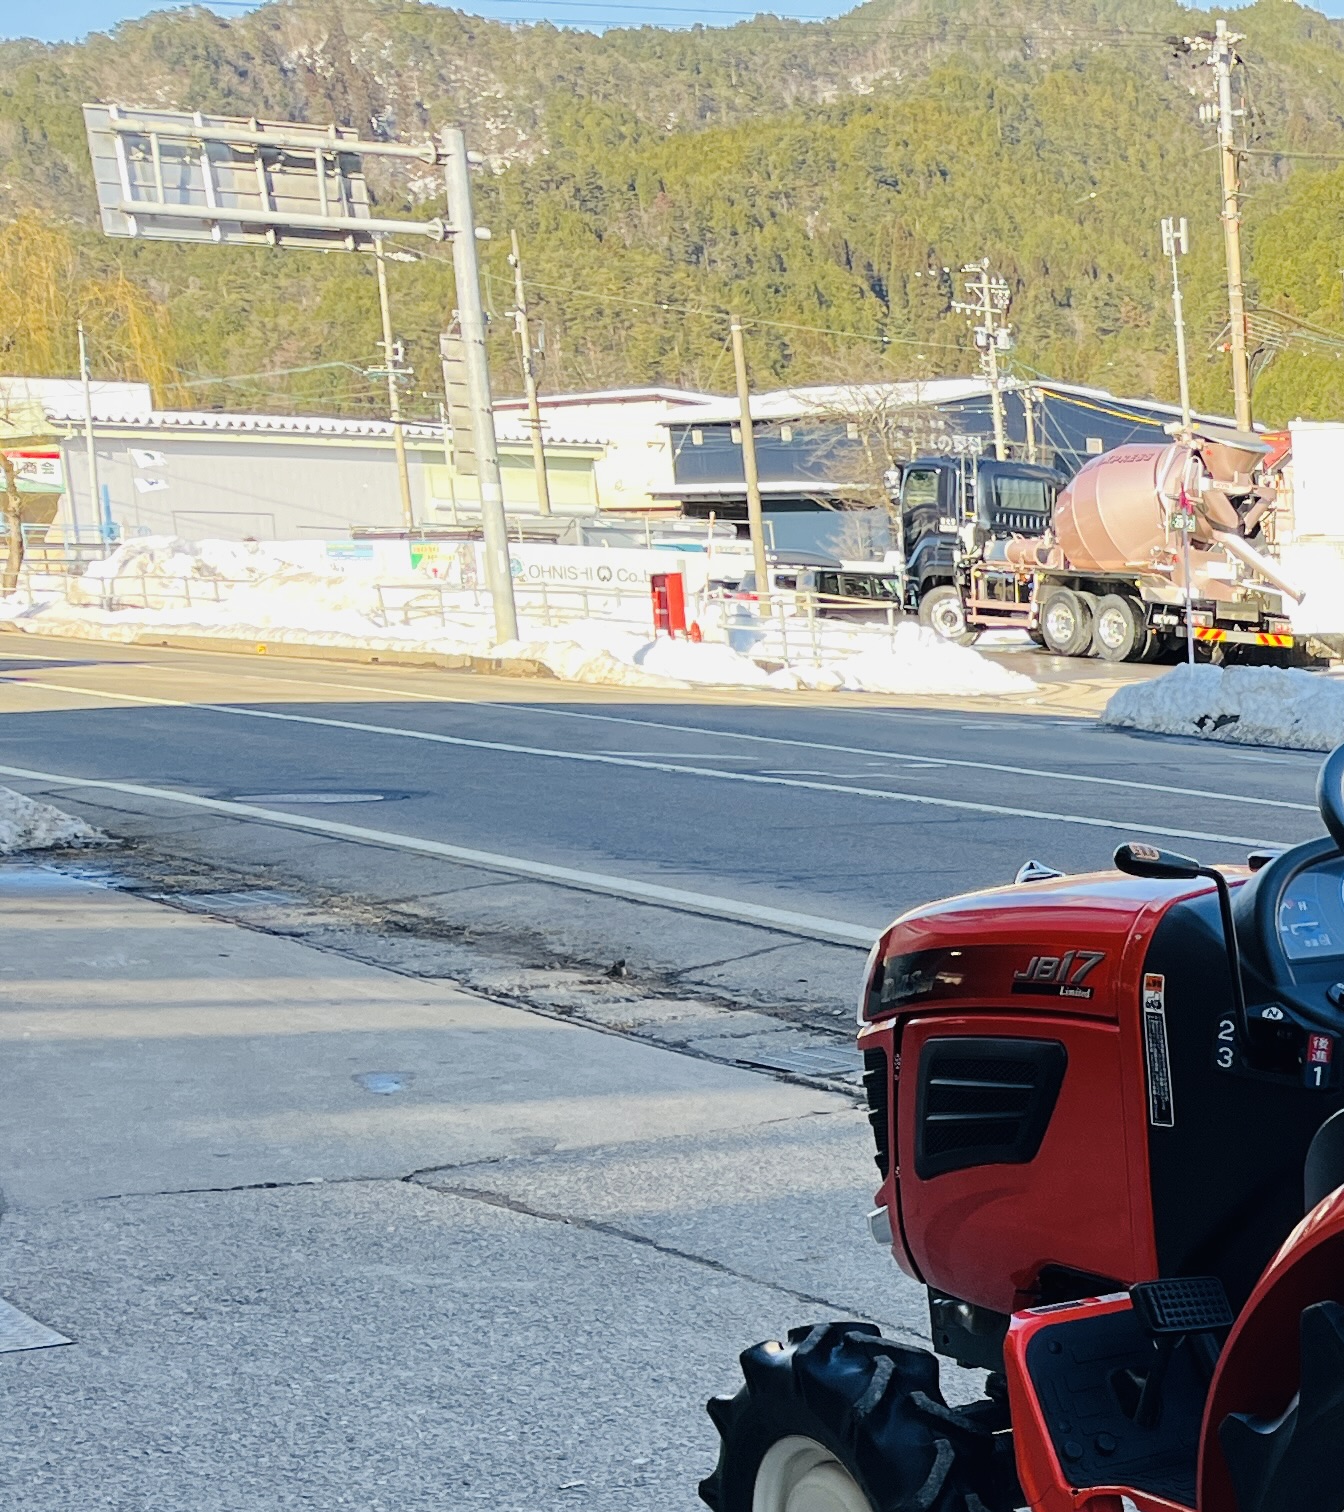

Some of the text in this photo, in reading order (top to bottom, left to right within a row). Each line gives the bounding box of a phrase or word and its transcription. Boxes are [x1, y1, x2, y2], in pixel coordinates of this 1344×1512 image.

[1013, 949, 1106, 985] JB17
[1059, 985, 1092, 999] Limited
[1217, 1020, 1235, 1042] 2
[1216, 1046, 1234, 1068] 3
[1311, 1036, 1330, 1063] 後進
[1313, 1065, 1322, 1087] 1
